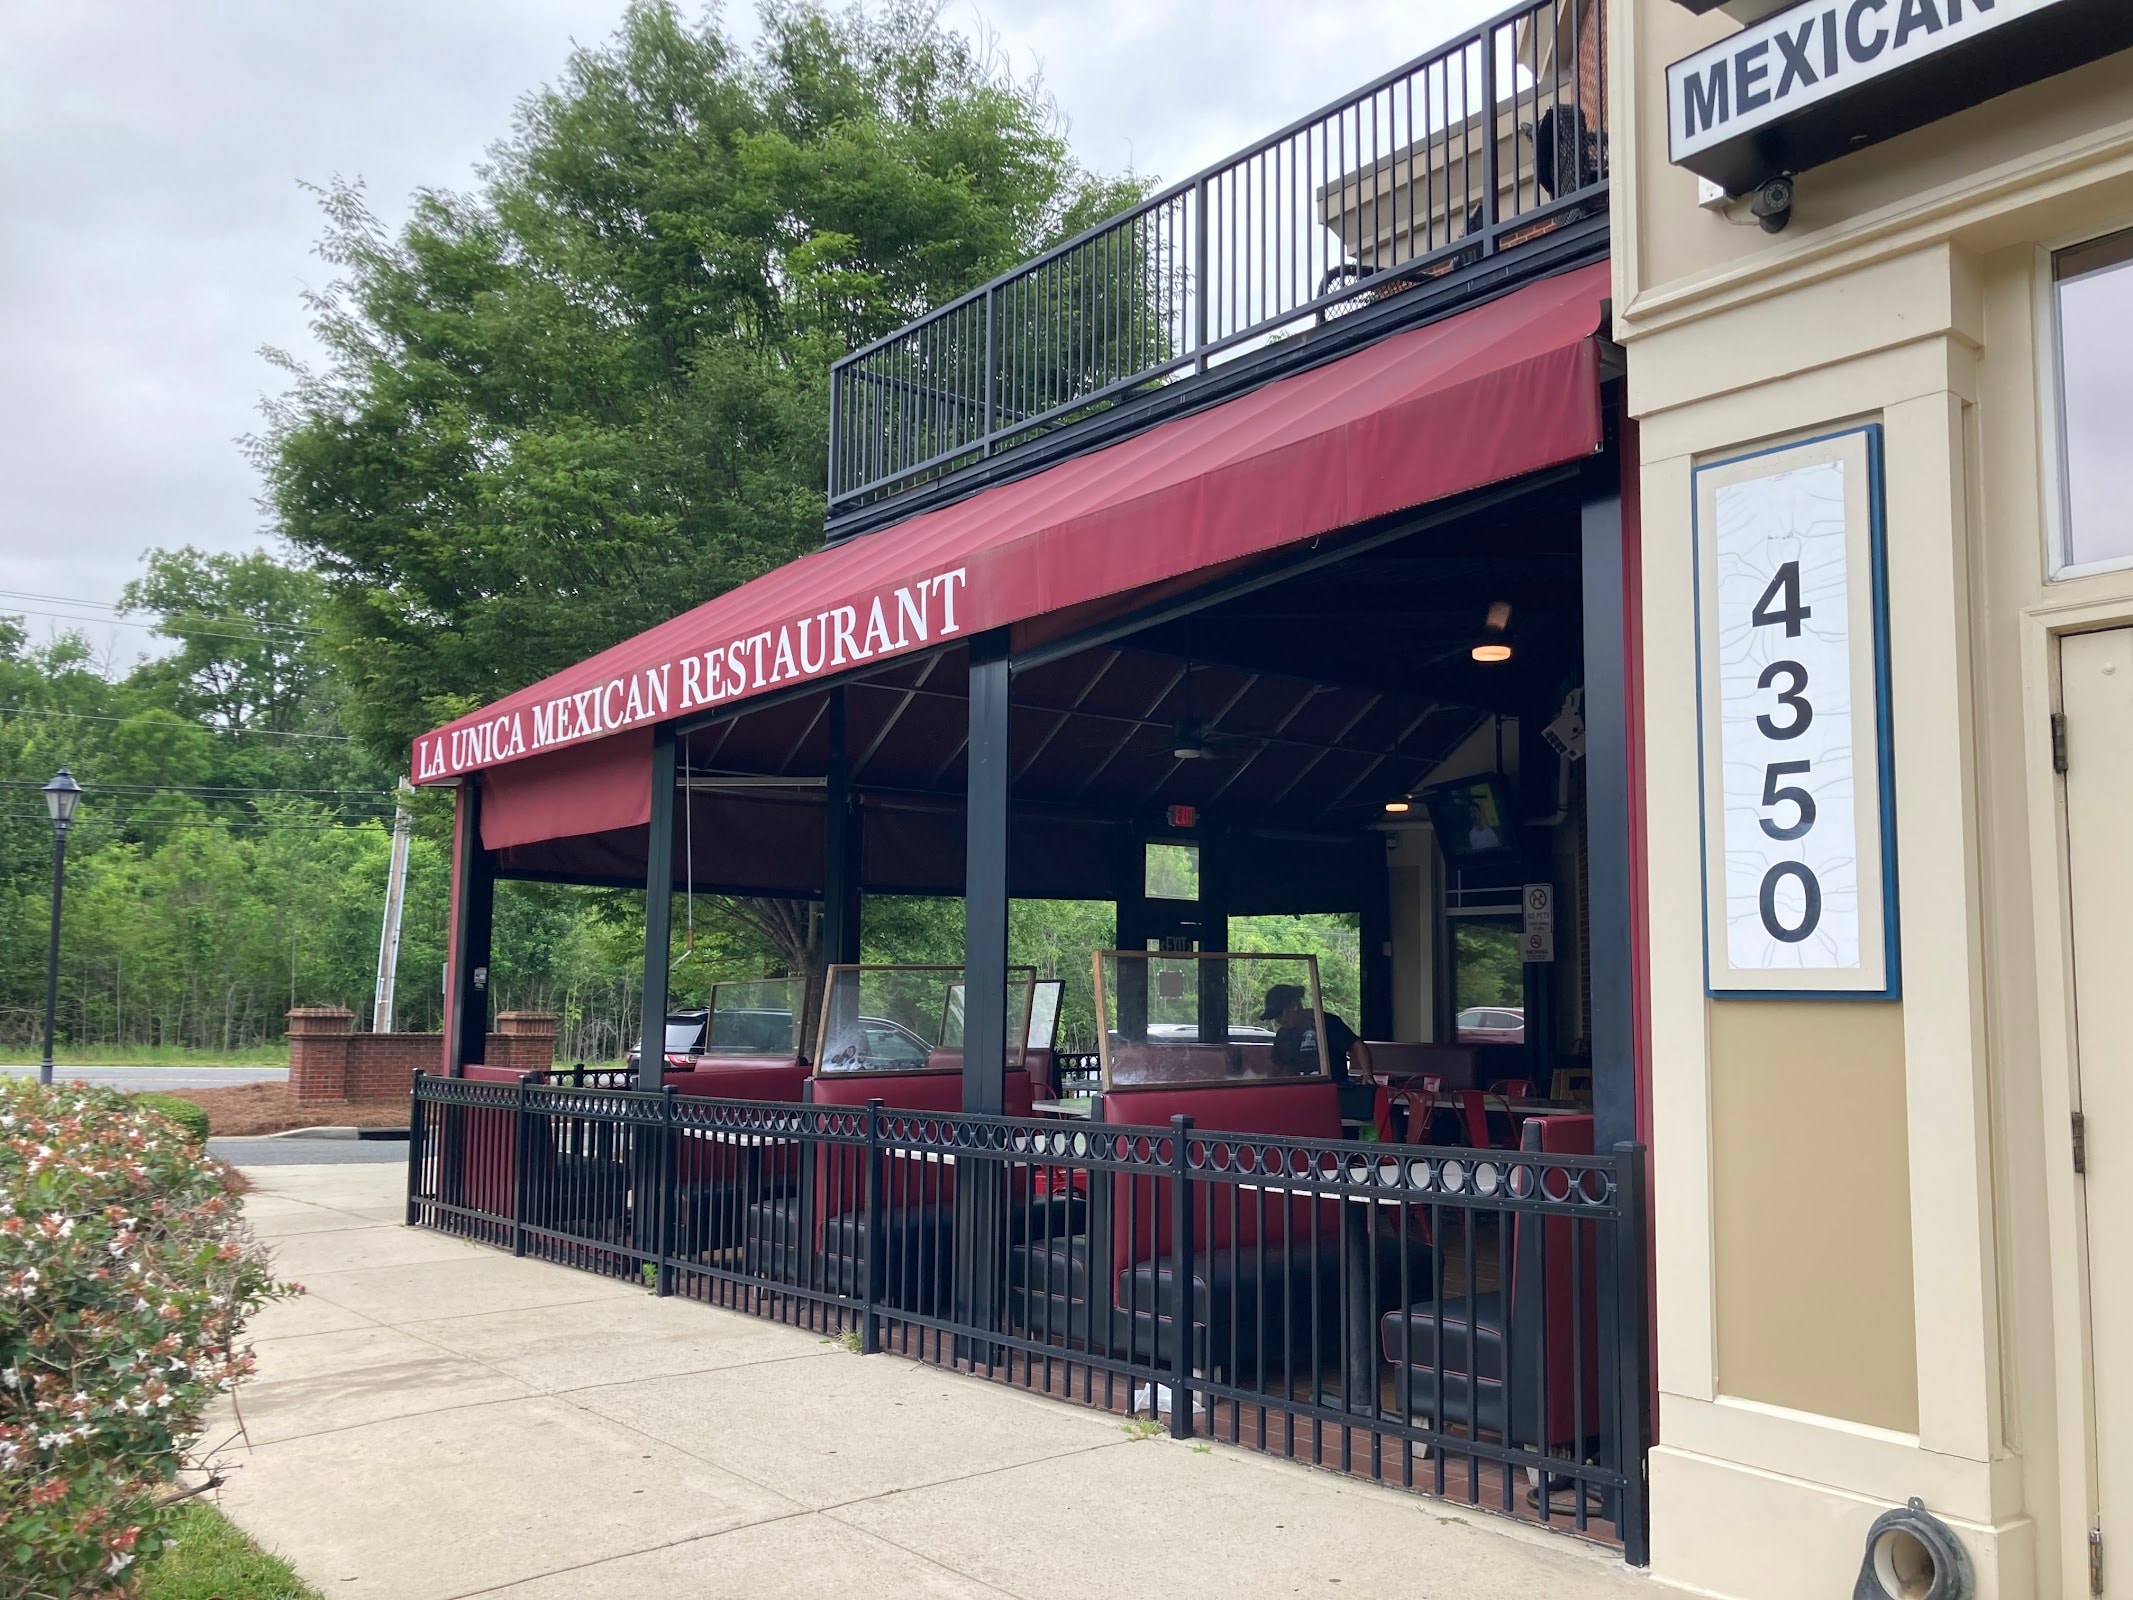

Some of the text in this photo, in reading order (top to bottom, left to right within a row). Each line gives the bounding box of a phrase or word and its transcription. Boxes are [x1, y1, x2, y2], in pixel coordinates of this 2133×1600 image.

[418, 567, 967, 779] LA UNICA MEXICAN RESTAURANT
[1751, 560, 1822, 944] 4350
[1175, 805, 1194, 825] EXIT
